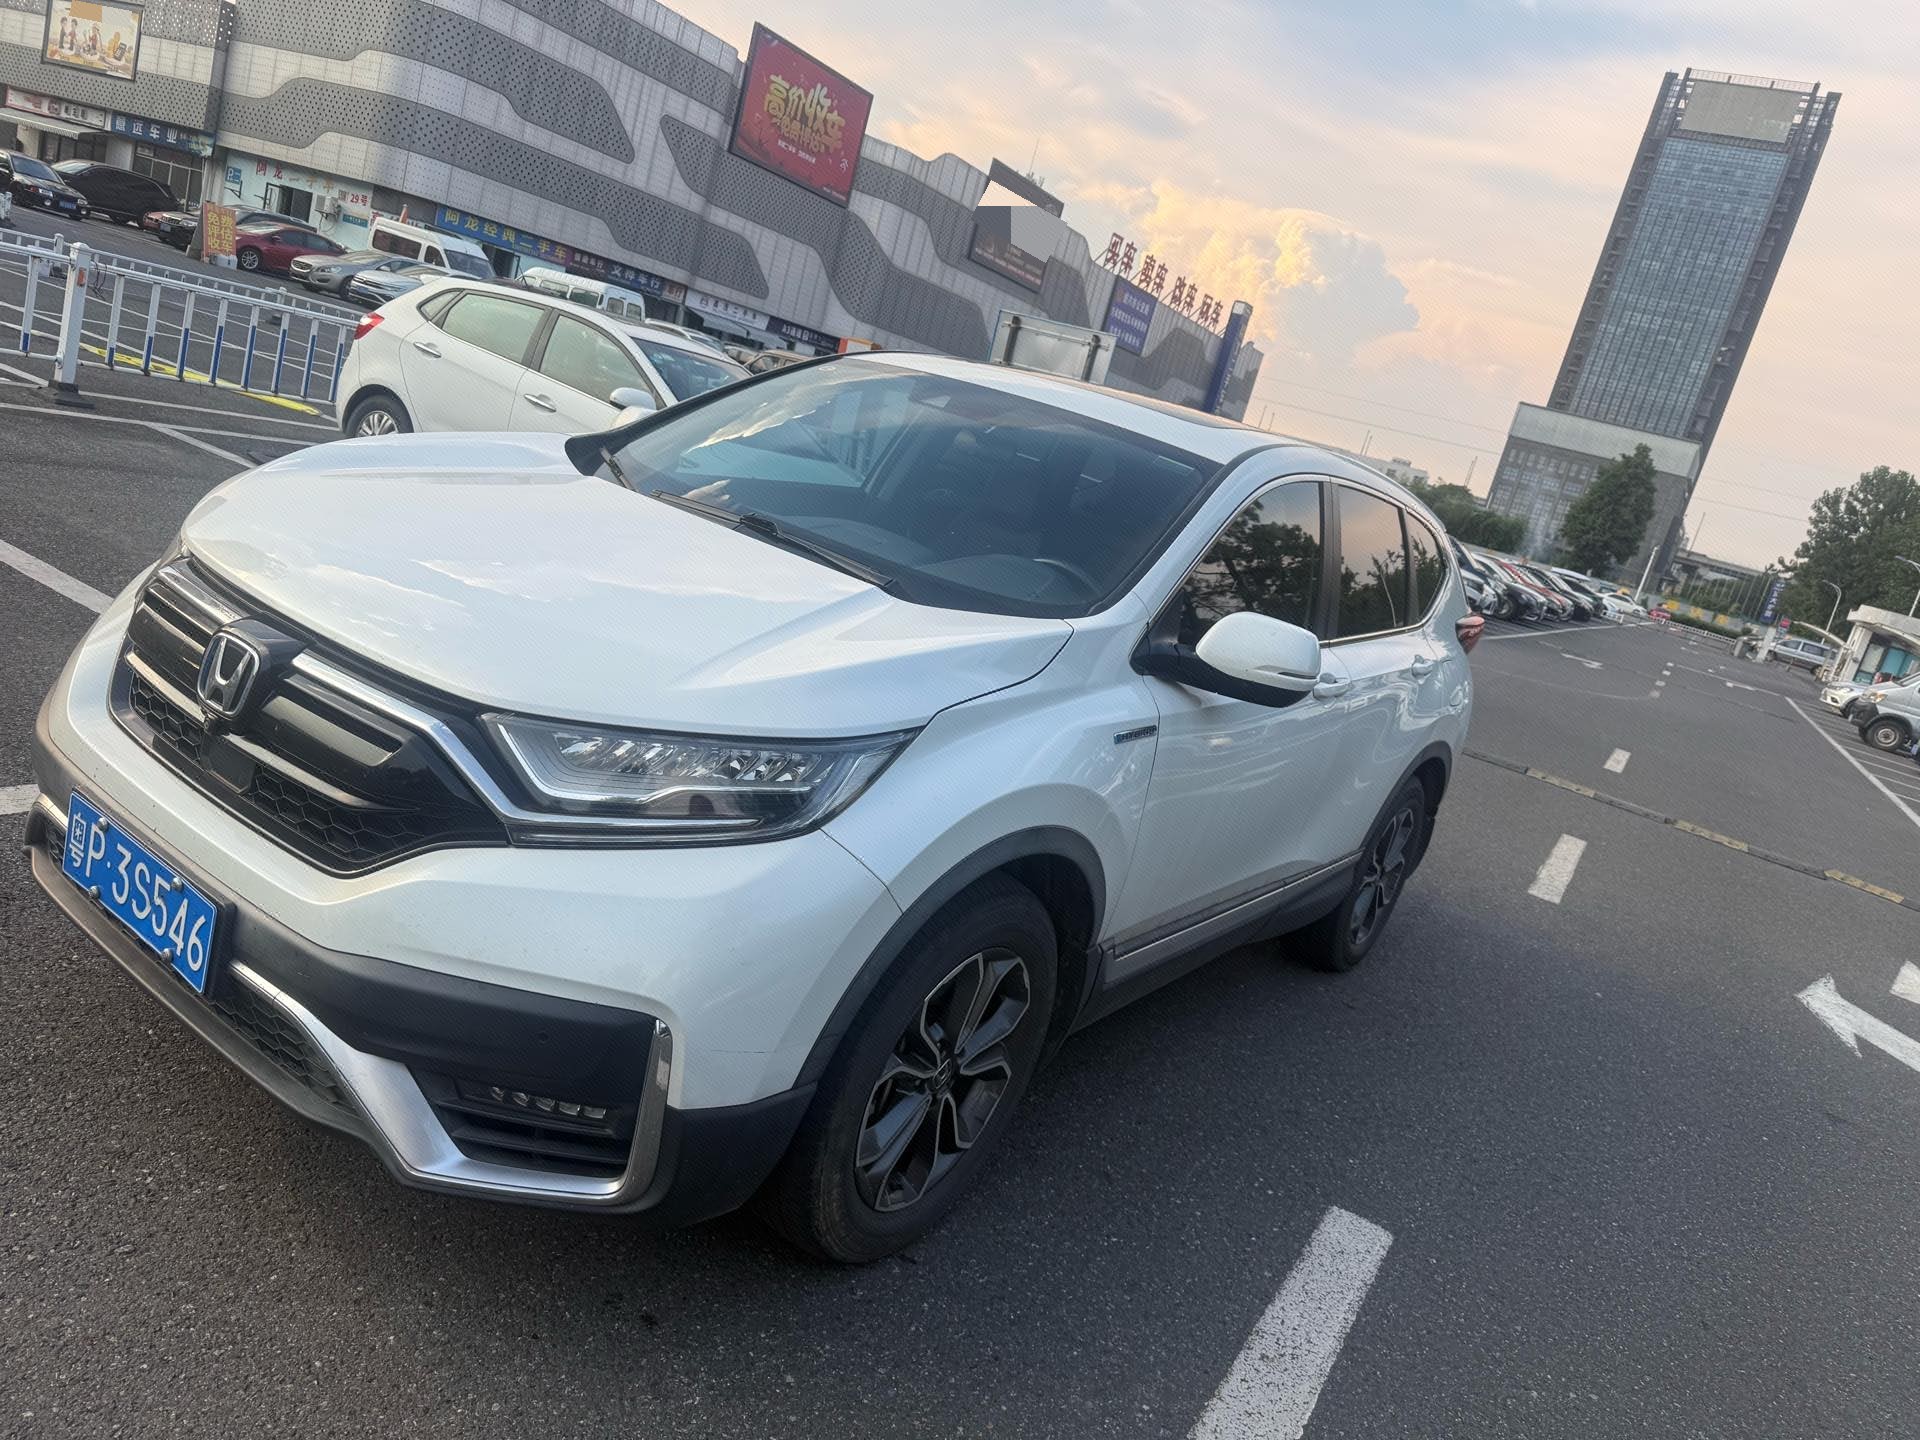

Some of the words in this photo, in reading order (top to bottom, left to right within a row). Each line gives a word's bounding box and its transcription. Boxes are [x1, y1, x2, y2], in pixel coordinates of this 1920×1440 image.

[764, 75, 846, 154] 高价收车
[350, 193, 369, 206] 29号
[208, 213, 233, 228] 免费
[445, 210, 567, 260] 阿龙经典二手车
